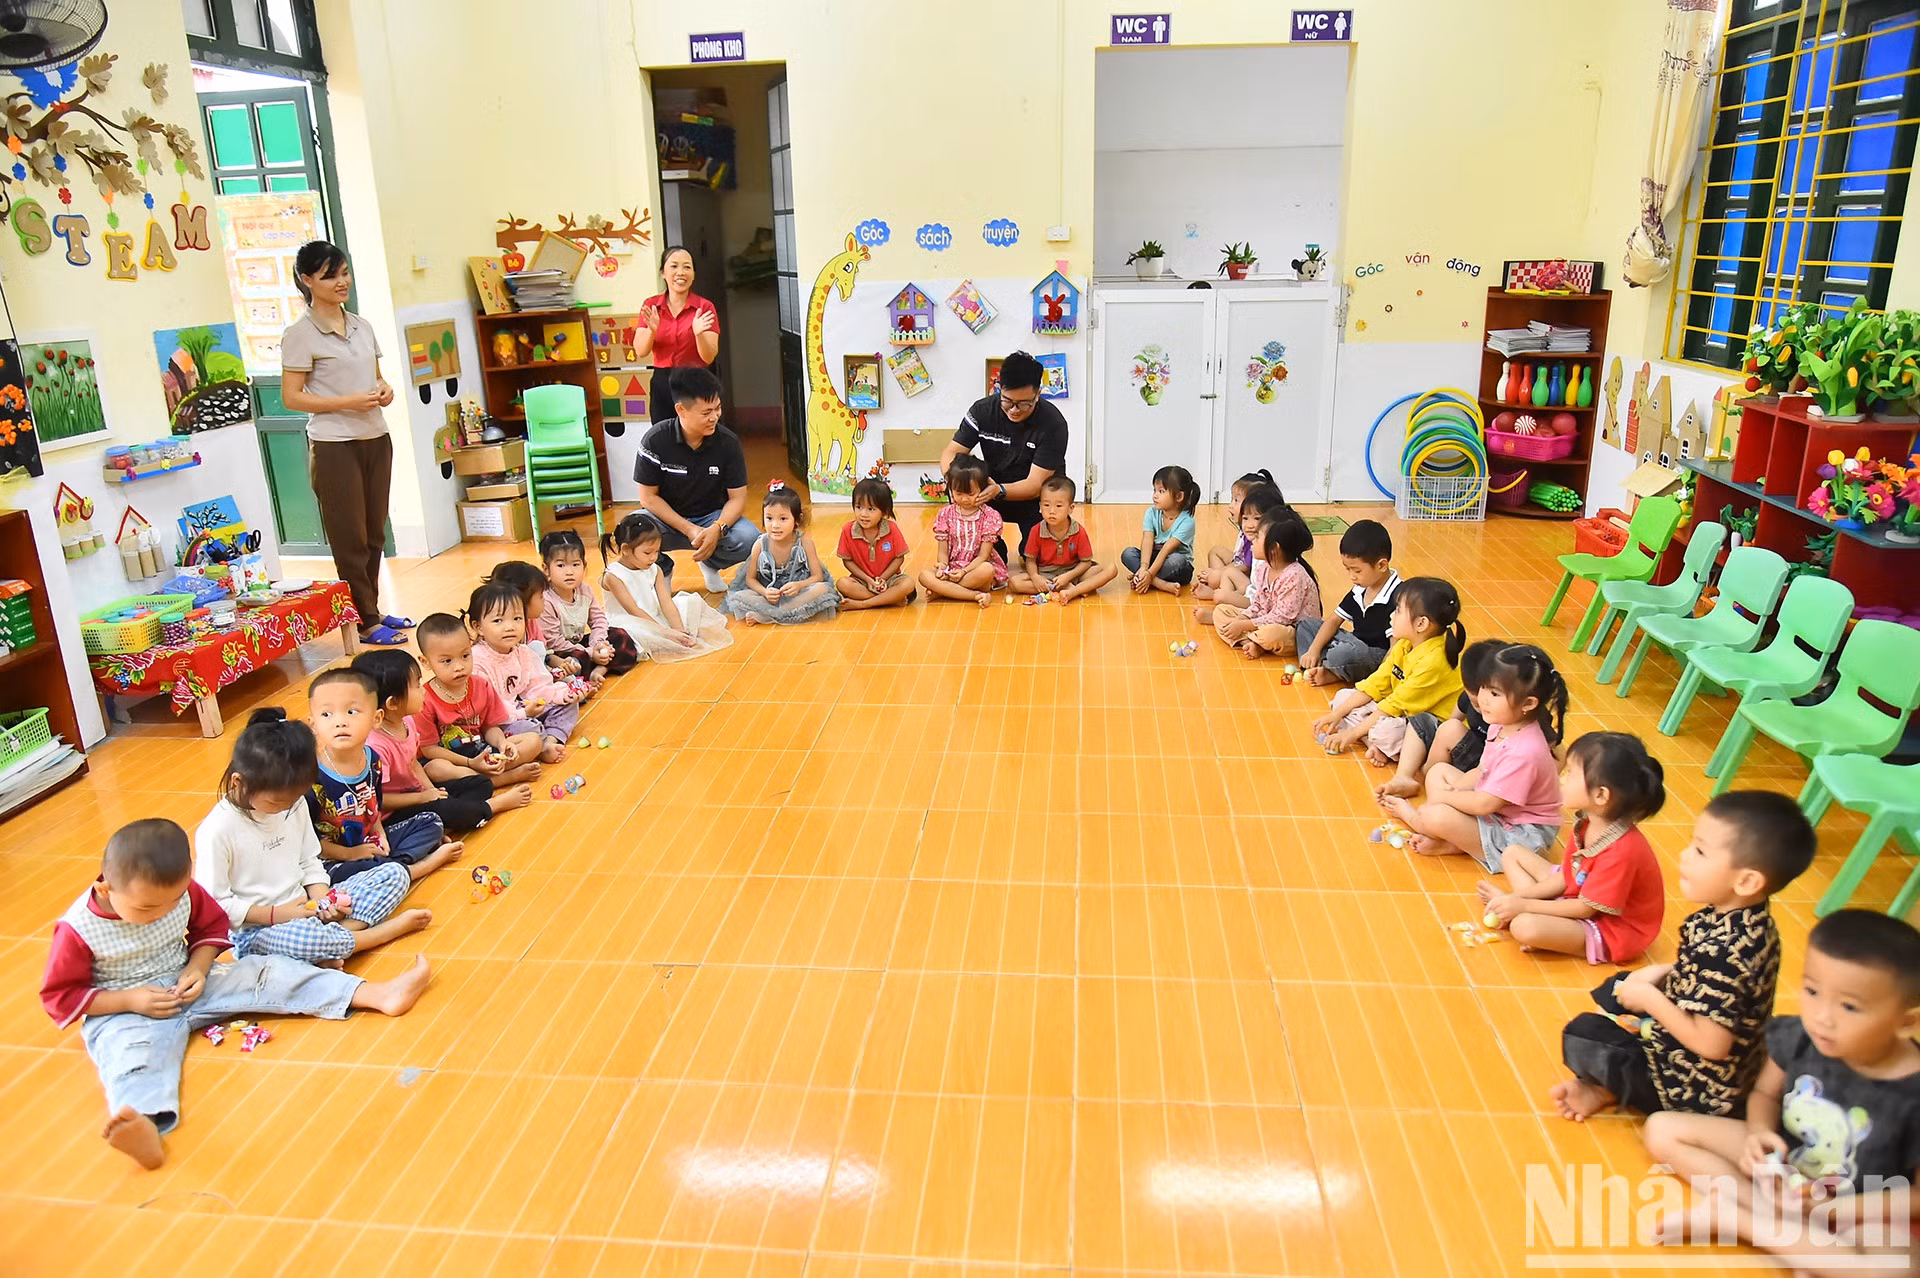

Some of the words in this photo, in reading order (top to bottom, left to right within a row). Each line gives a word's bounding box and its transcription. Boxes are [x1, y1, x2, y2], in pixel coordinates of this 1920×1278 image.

[1115, 18, 1148, 34] WC
[1297, 14, 1329, 30] WC
[1304, 31, 1319, 39] NỮ
[692, 37, 723, 59] PHÒNG
[723, 39, 742, 57] KHO
[860, 223, 885, 242] Góc
[919, 228, 950, 245] sách
[983, 224, 1018, 243] truyện
[1355, 262, 1385, 278] Góc
[1405, 252, 1430, 267] vận
[1446, 258, 1481, 277] động
[600, 351, 608, 363] 3
